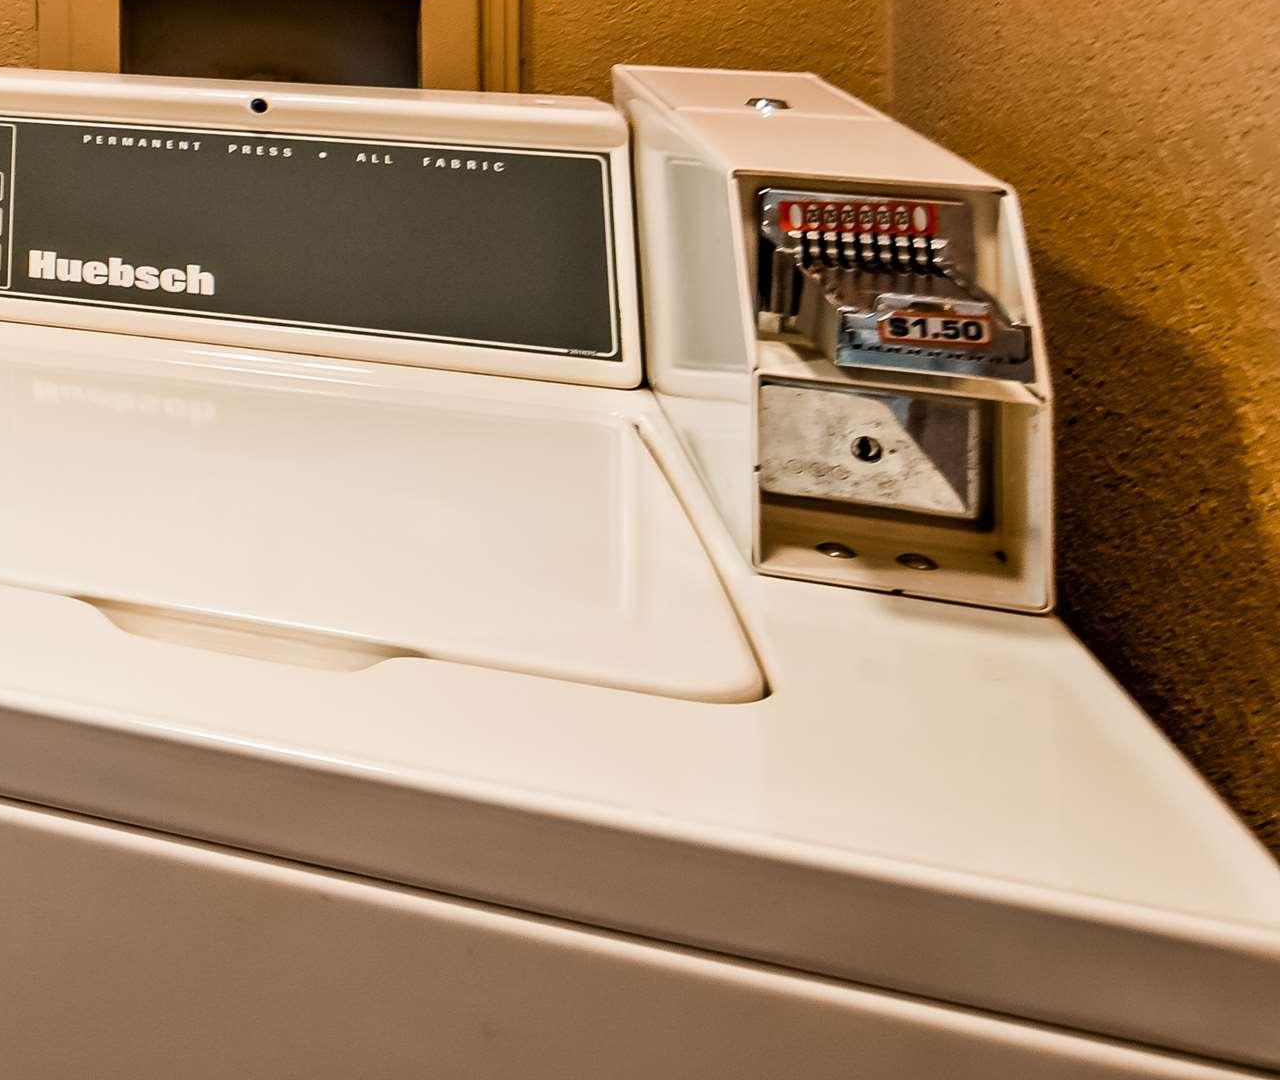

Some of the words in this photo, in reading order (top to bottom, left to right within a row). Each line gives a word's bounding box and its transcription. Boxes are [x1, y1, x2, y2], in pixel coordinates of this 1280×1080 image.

[83, 134, 203, 151] PERMANENT
[228, 144, 293, 158] PRESS
[356, 153, 394, 165] ALL
[423, 156, 506, 173] FABRIC
[28, 250, 215, 296] Huebsch
[888, 318, 984, 341] $1.50
